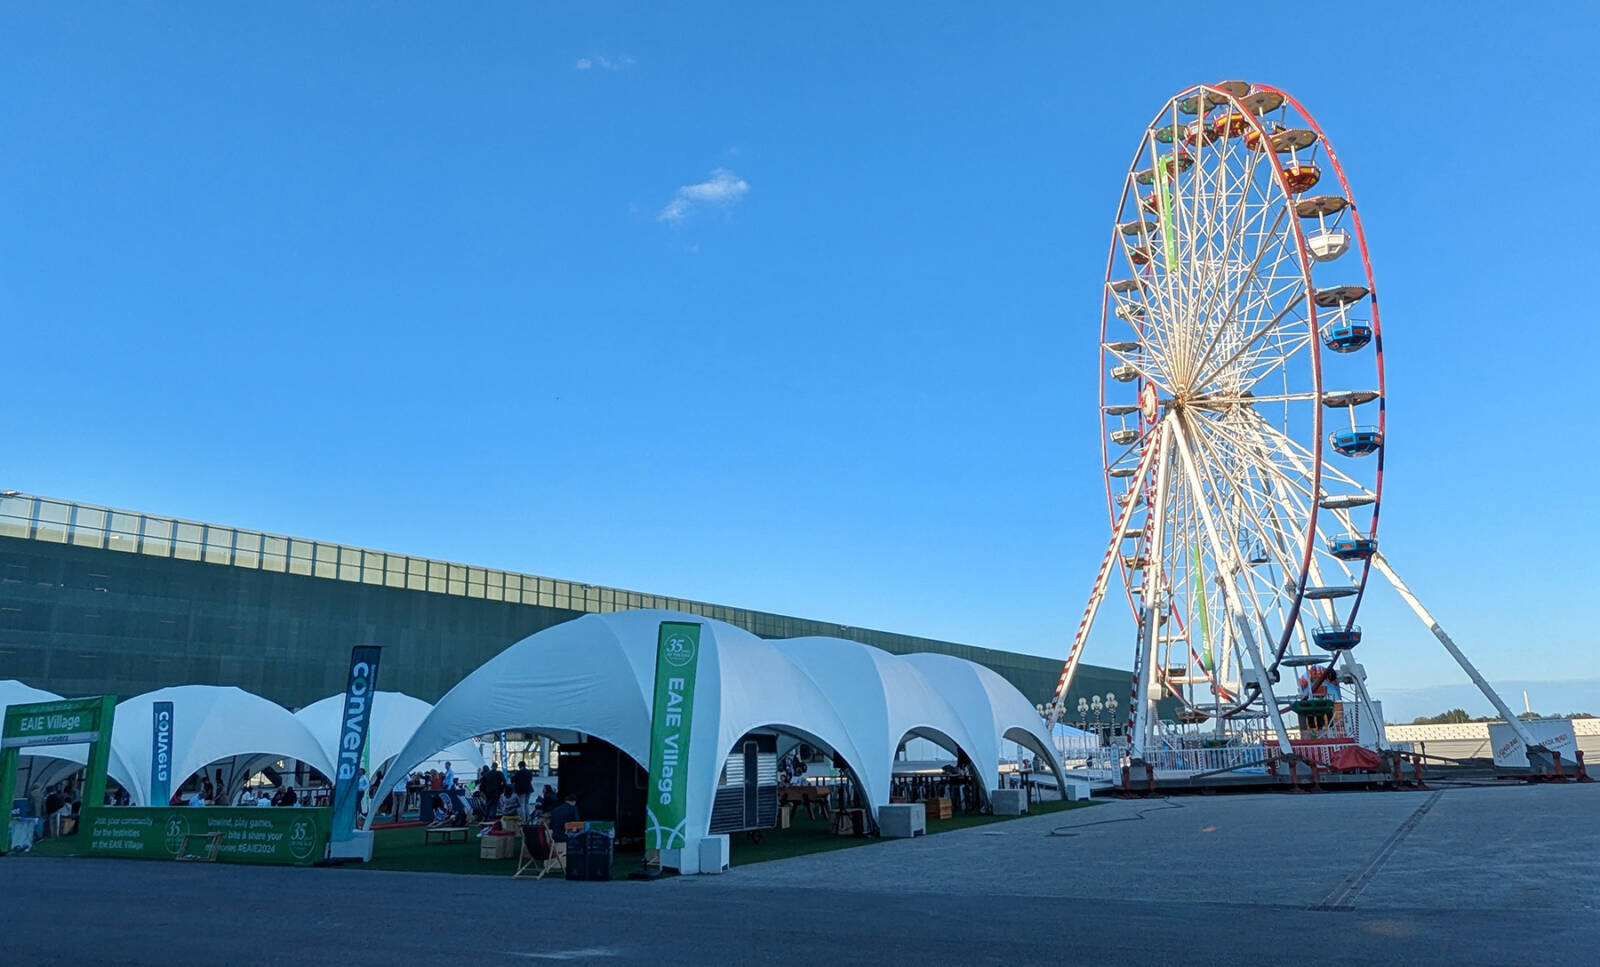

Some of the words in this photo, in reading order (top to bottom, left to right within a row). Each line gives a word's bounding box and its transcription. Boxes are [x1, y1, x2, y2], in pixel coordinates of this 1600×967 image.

[666, 638, 685, 653] 35
[665, 677, 685, 727] EAIE
[20, 716, 45, 732] EAIE
[47, 713, 81, 730] Village
[339, 662, 369, 780] convera
[658, 733, 680, 806] Village
[166, 820, 182, 837] 35
[234, 817, 248, 829] play
[291, 822, 308, 841] 35
[102, 828, 112, 837] the
[267, 832, 284, 842] your
[99, 840, 108, 848] the
[124, 840, 144, 850] Village
